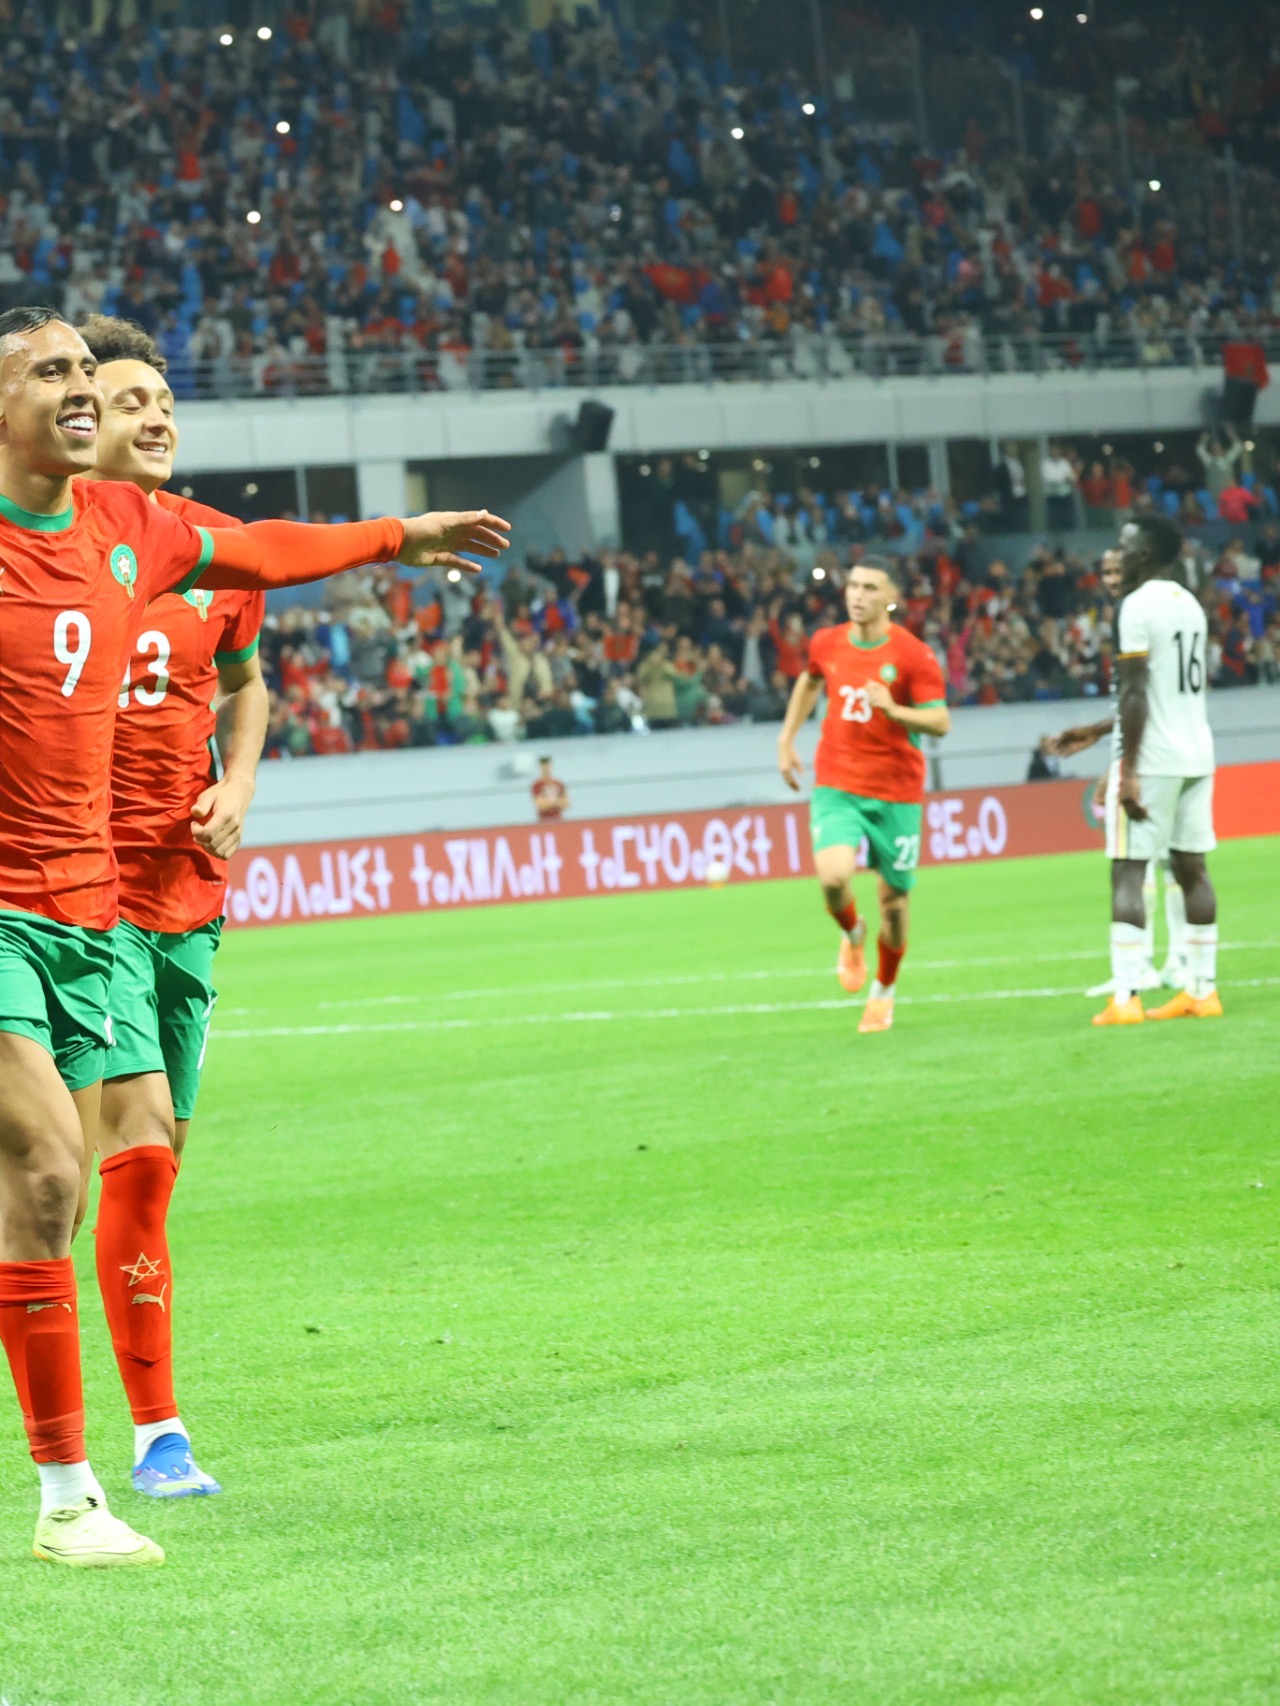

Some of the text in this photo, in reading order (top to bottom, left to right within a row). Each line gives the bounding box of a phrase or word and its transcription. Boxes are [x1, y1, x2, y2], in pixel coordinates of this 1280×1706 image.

[53, 610, 91, 697] 9
[1173, 630, 1202, 694] 16
[839, 685, 872, 724] 23
